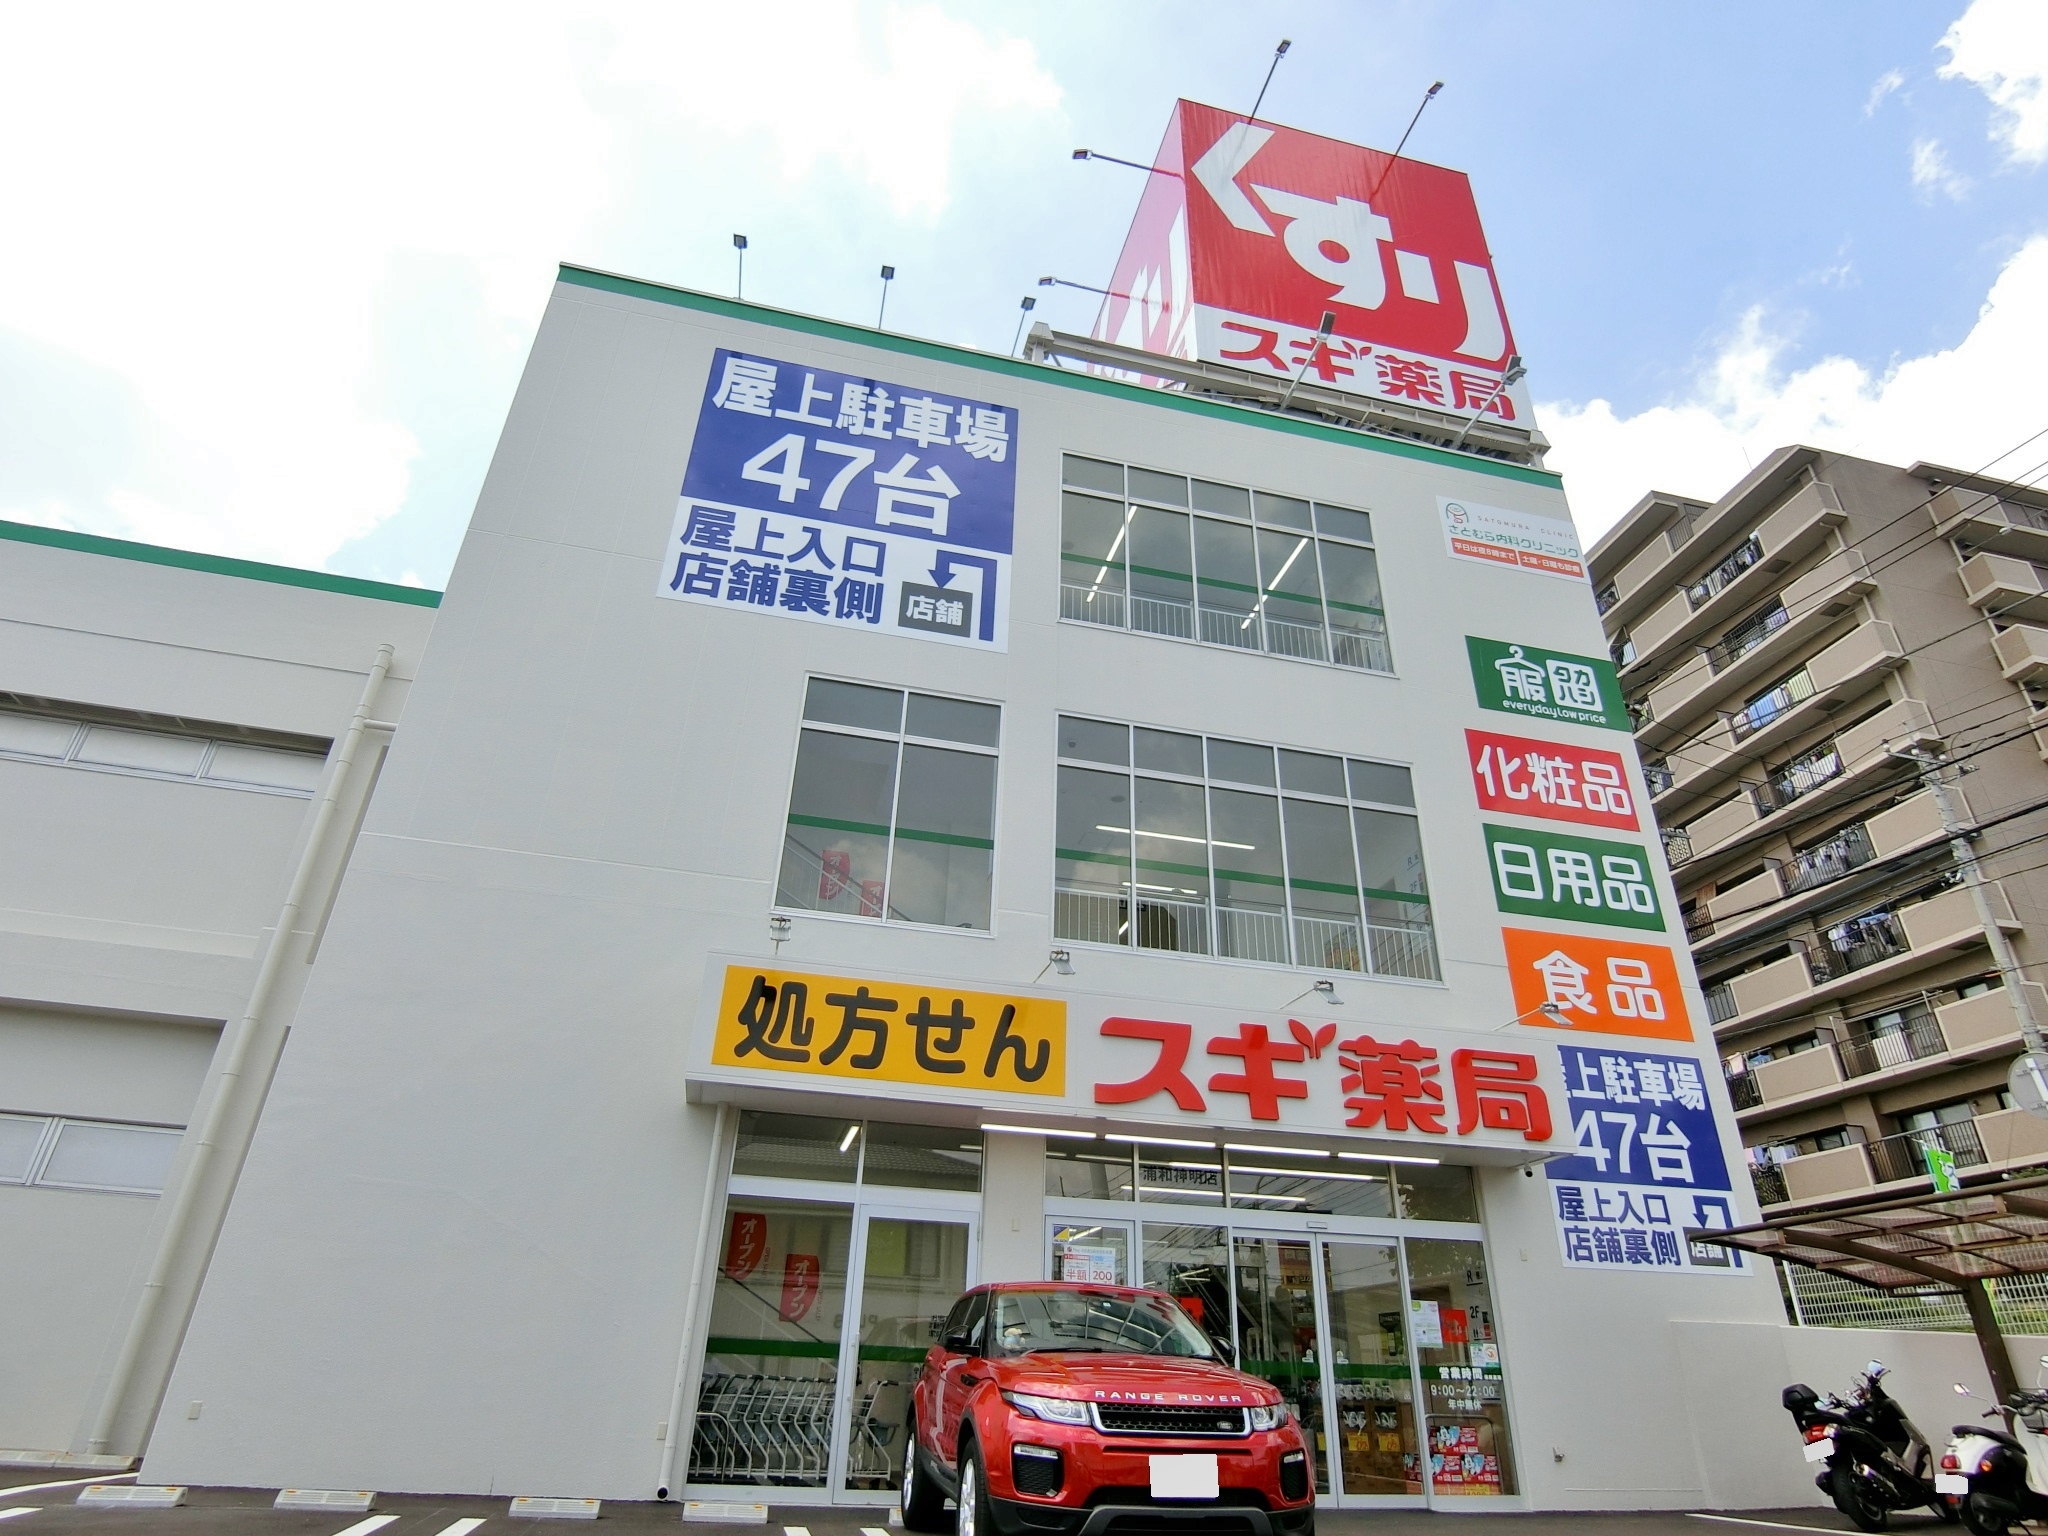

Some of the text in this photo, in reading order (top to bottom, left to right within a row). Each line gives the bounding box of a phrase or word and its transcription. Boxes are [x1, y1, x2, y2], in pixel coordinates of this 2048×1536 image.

[1191, 121, 1506, 362] くすり
[1219, 321, 1516, 421] スギ薬局
[712, 357, 1010, 463] 屋上駐車場
[741, 433, 962, 537] 47台
[680, 504, 887, 578] 屋上入口
[1449, 524, 1579, 559] さとむら内科クリニック
[1477, 515, 1575, 540] SATOMURA CLINIC
[670, 552, 886, 625] 店舗裏側
[905, 595, 965, 626] 店舗
[1476, 744, 1632, 817] 化粧品
[1493, 841, 1655, 915] 日用品
[1532, 949, 1665, 1021] 食品
[733, 975, 1051, 1083] 処方せん
[1094, 1016, 1553, 1142] スギ薬局
[1559, 1048, 1707, 1111] 上駐車場
[1573, 1109, 1692, 1184] 47台
[1555, 1185, 1672, 1226] 屋上入口
[1563, 1225, 1682, 1267] 店舗裏側
[1094, 1390, 1242, 1402] RANGE ROVER
[1438, 1366, 1483, 1381] 営業時間
